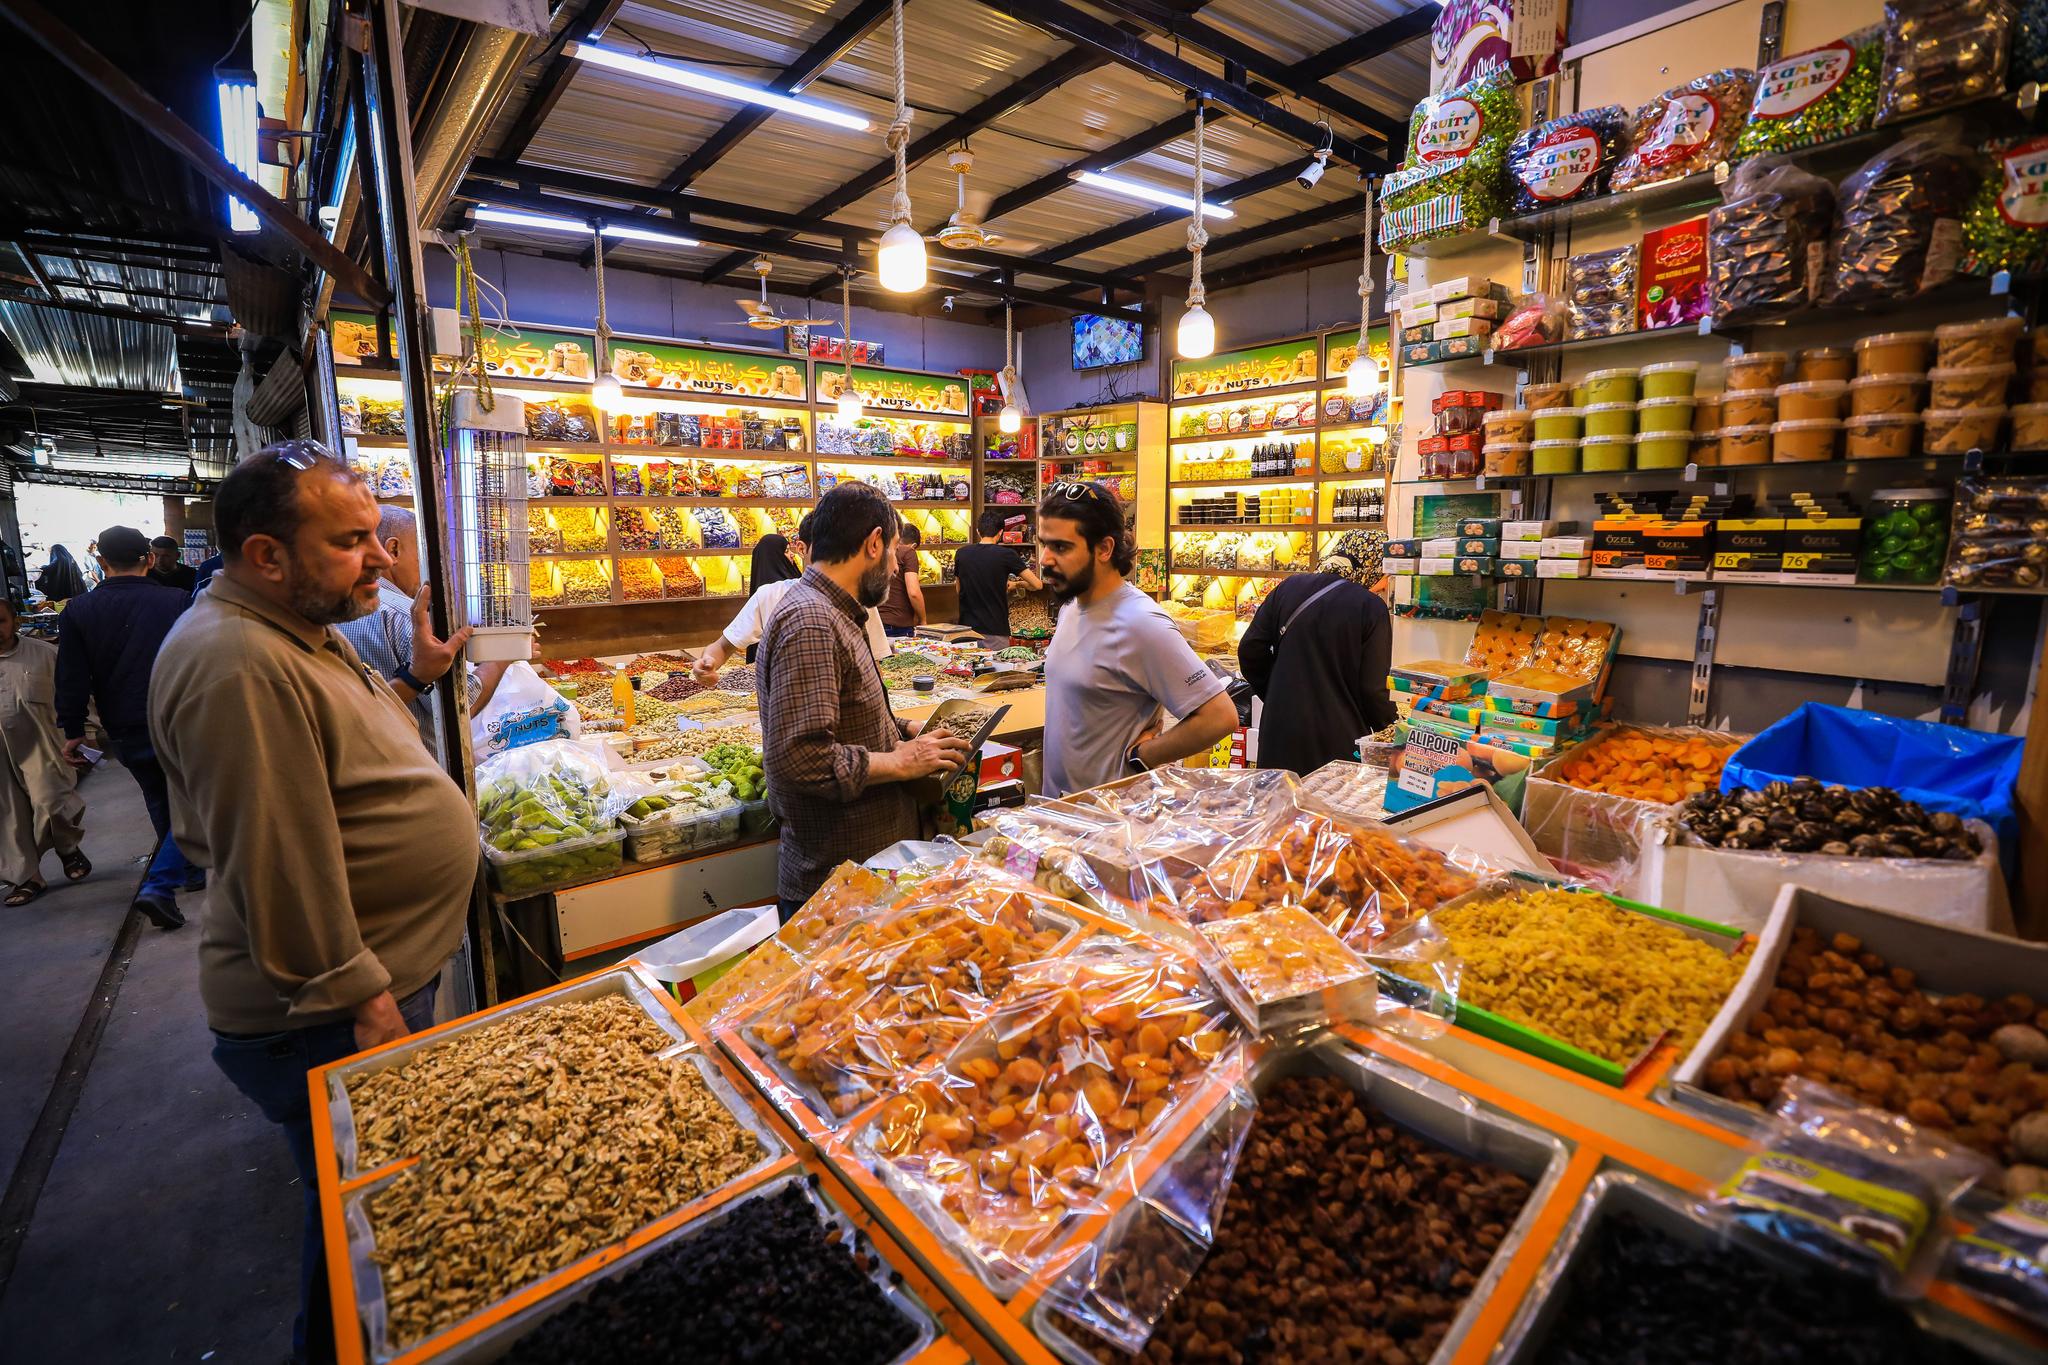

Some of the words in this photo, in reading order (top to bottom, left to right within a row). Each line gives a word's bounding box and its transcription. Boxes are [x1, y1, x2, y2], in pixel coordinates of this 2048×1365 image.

[1422, 110, 1476, 133] FRUITY
[1421, 130, 1469, 145] CANDY
[653, 358, 700, 375] الجود
[704, 358, 769, 380] كرزات
[1237, 356, 1289, 373] كرزات
[692, 380, 734, 390] NUTS
[890, 381, 939, 397] كرزات
[1226, 377, 1260, 389] NUTS
[880, 398, 912, 407] NUTS
[1605, 534, 1636, 544] ÖZEL
[1657, 540, 1689, 549] ÖZEL
[1731, 535, 1767, 545] ÖZEL
[1801, 535, 1840, 545] ÖZEL
[1184, 669, 1205, 684] UNDER
[1188, 673, 1207, 687] ARMOUR
[515, 717, 549, 732] NUTS
[1494, 715, 1516, 724] ALIPOUR
[1407, 730, 1460, 756] ALIPOUR
[1405, 744, 1426, 757] DRIED
[1425, 751, 1457, 766] APRICOTS
